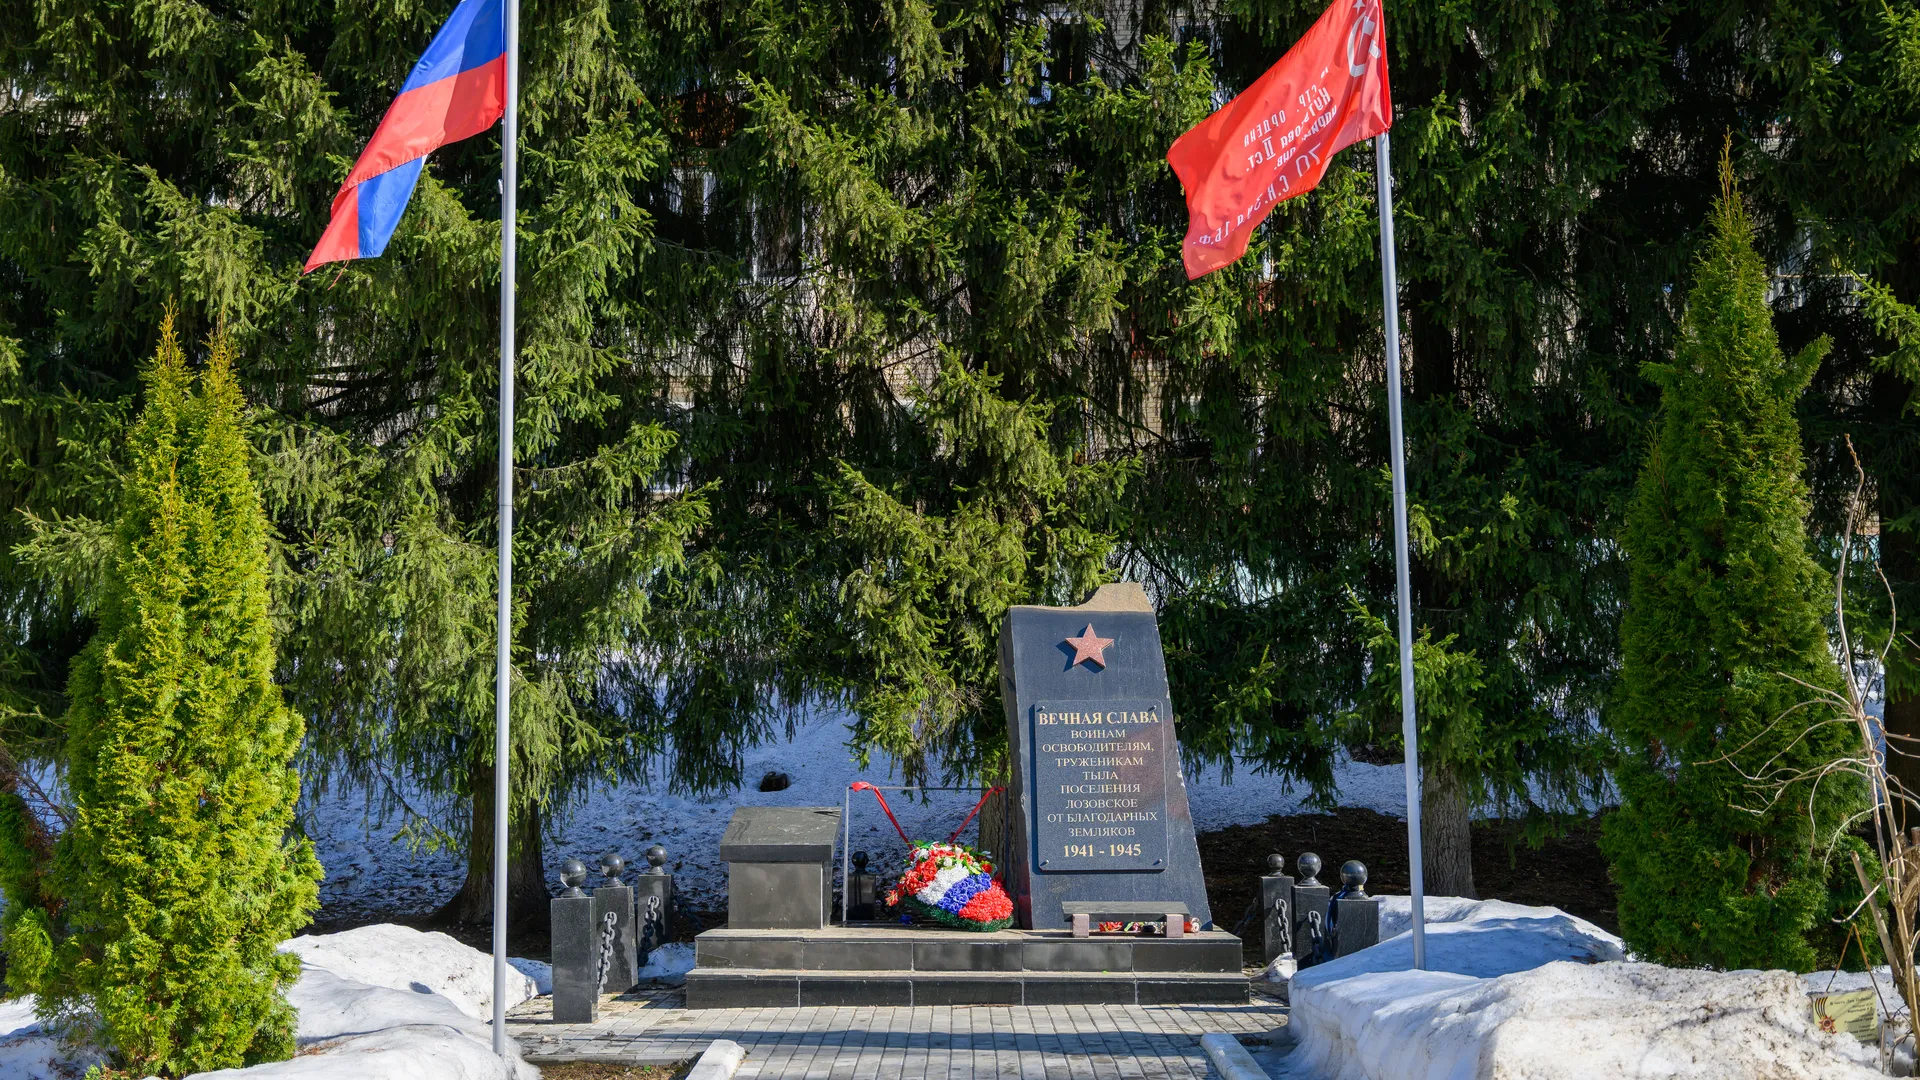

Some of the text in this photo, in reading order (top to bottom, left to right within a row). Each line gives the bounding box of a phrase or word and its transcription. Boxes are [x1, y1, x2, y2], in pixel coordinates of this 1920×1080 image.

[1039, 711, 1159, 725] ВЕЧНАЯ СЛАВА
[1071, 729, 1126, 739] ВОИНАМ
[1042, 742, 1155, 753] ОСВОБОДИТЕЛЯМ,
[1055, 757, 1144, 767] ТРУЖЕНИКАМ
[1082, 771, 1119, 780] ТЫЛА
[1061, 783, 1141, 794] ПОСЕЛЕНИЯ
[1066, 798, 1138, 809] ЛОЗОВСКОЕ
[1047, 812, 1158, 823] ОТ БЛАГОДАРНЫХ
[1068, 827, 1136, 837] ЗЕМЛЯКОВ
[1063, 844, 1094, 857] 1941
[1109, 843, 1142, 857] 1945
